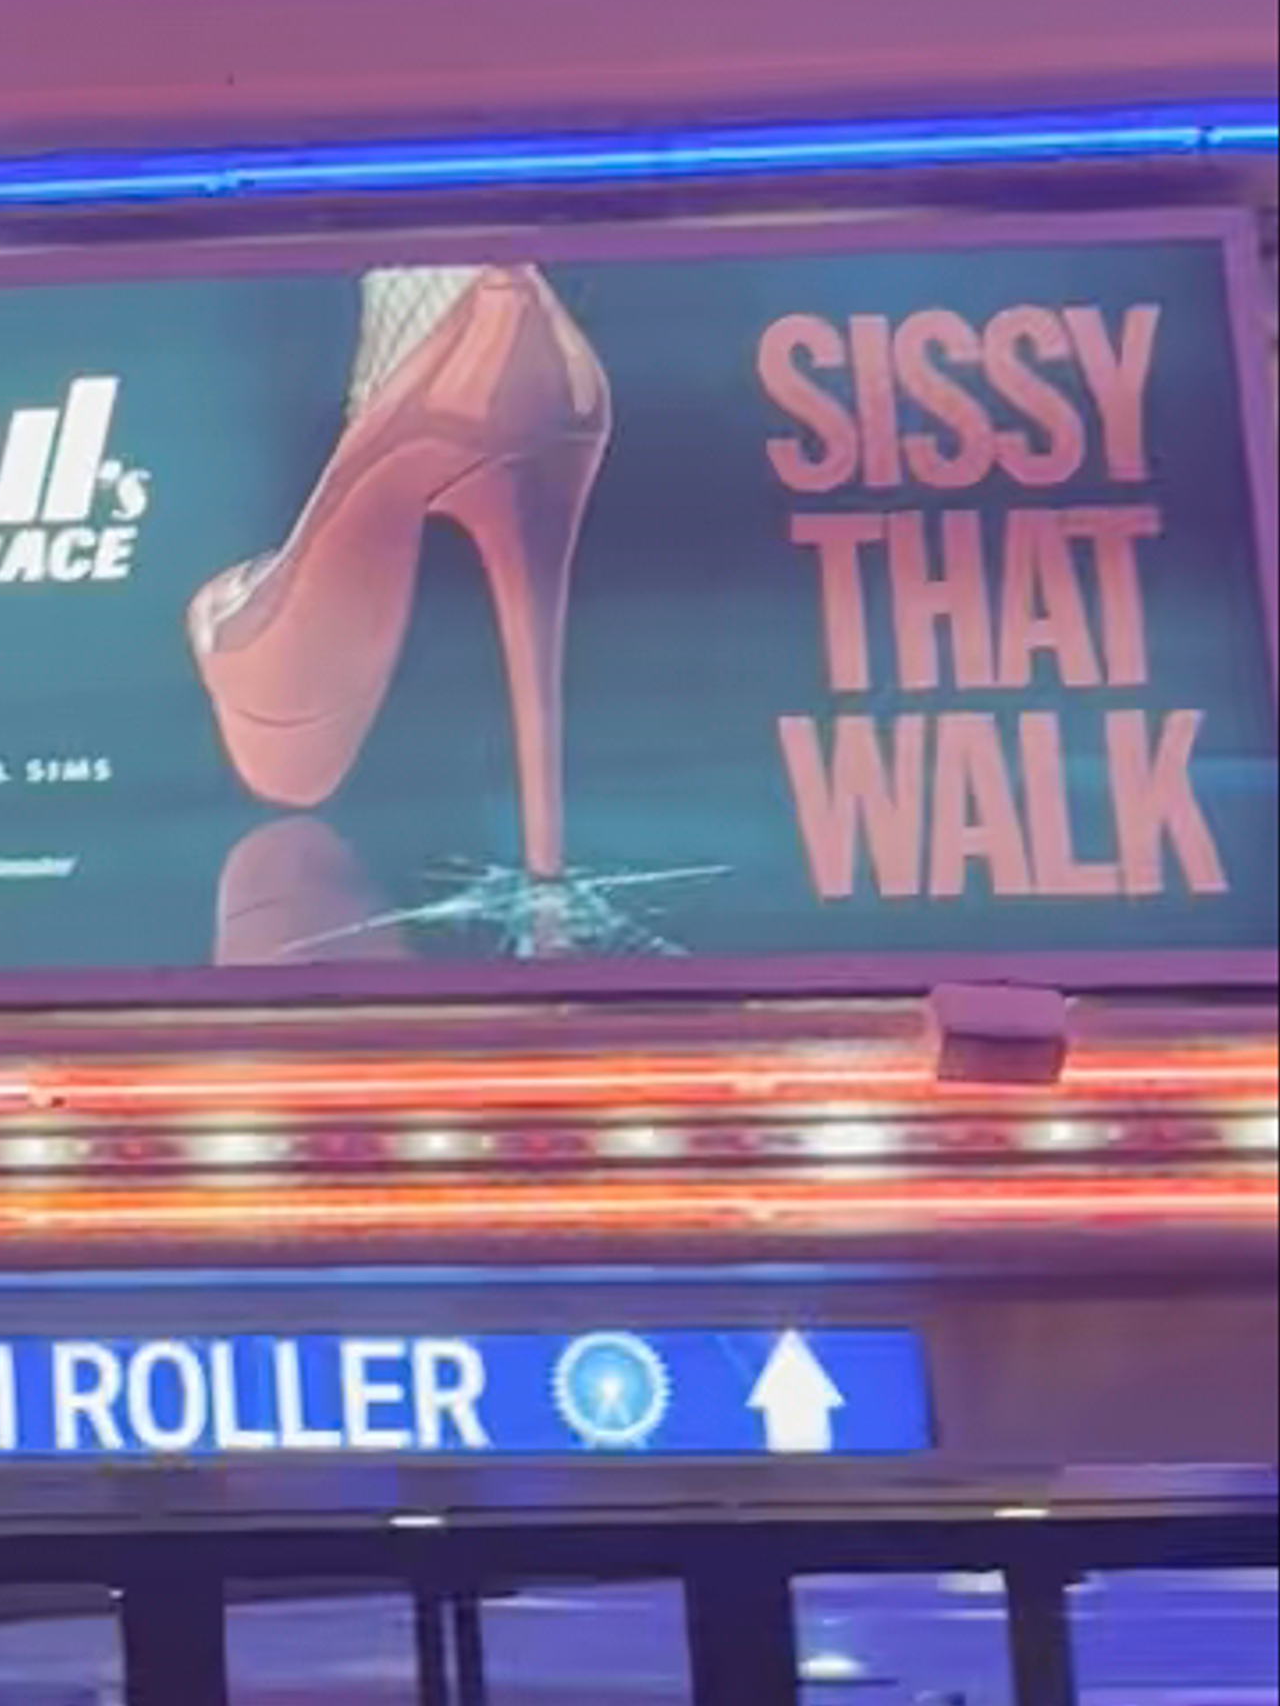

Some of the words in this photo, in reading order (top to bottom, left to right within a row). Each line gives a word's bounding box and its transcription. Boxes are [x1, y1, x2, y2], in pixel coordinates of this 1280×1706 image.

[757, 303, 1161, 492] SISSY
[790, 505, 1163, 693] THAT
[26, 757, 112, 784] SIMS
[777, 708, 1230, 897] WALK
[52, 1337, 490, 1451] ROLLER
